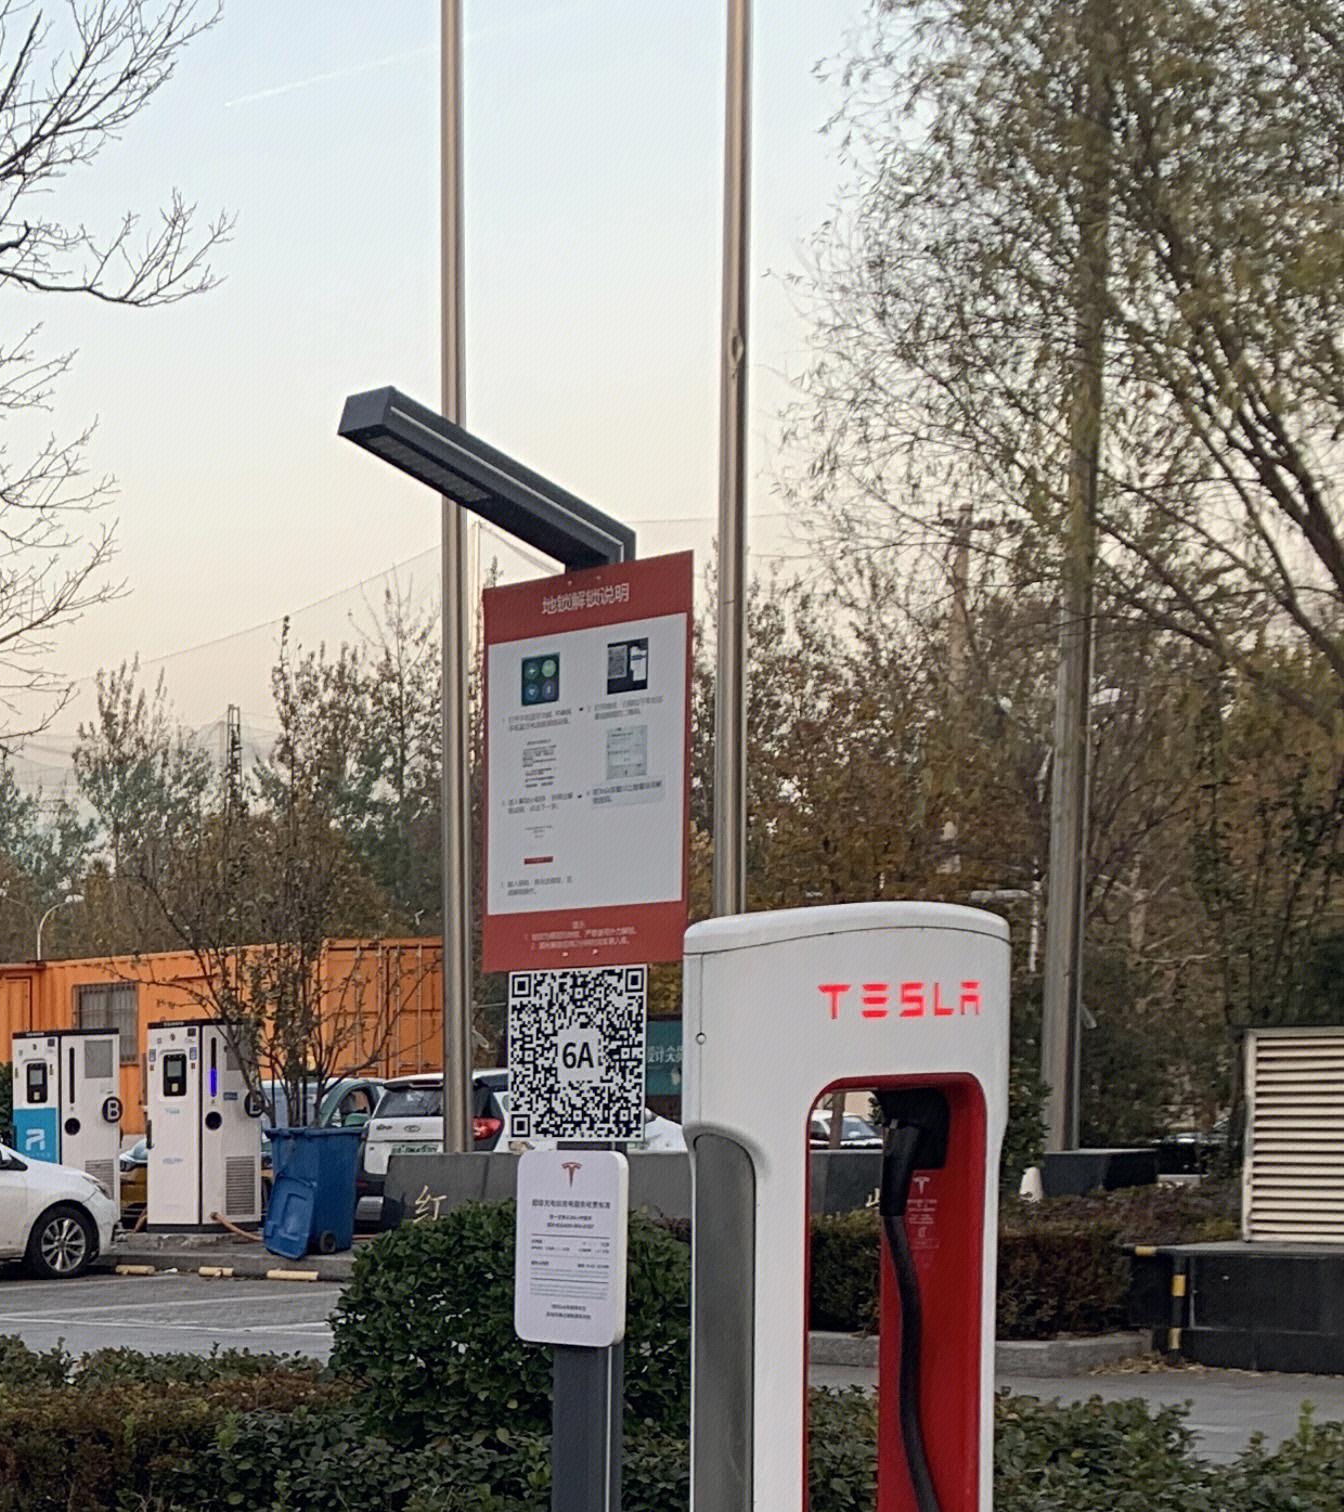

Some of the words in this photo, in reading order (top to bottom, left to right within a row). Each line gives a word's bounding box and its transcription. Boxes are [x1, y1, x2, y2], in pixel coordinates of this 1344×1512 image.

[541, 583, 630, 614] 地锁解锁说明
[817, 980, 982, 1020] TESLA
[561, 1040, 594, 1070] 6A
